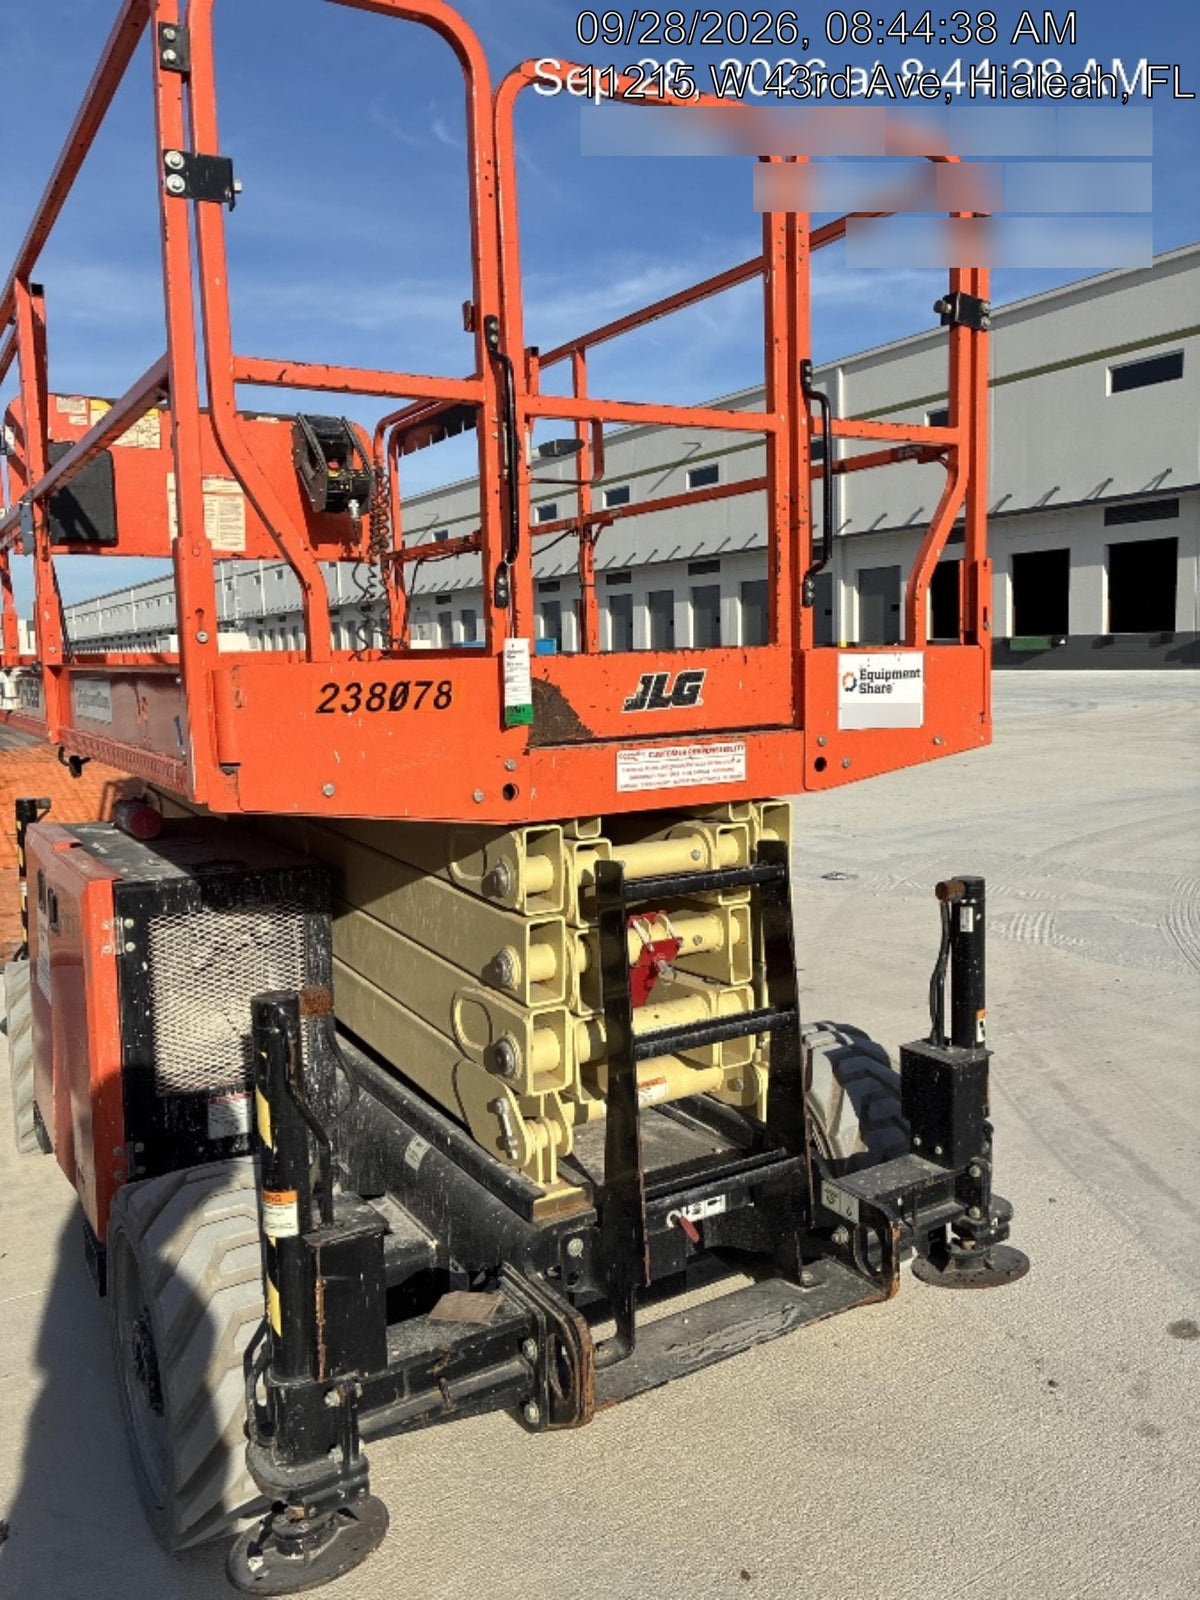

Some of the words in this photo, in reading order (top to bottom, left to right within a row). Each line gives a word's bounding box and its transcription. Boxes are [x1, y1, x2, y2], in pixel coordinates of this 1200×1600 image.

[859, 667, 921, 682] Equipment
[622, 669, 706, 713] JLG
[859, 682, 893, 694] Share
